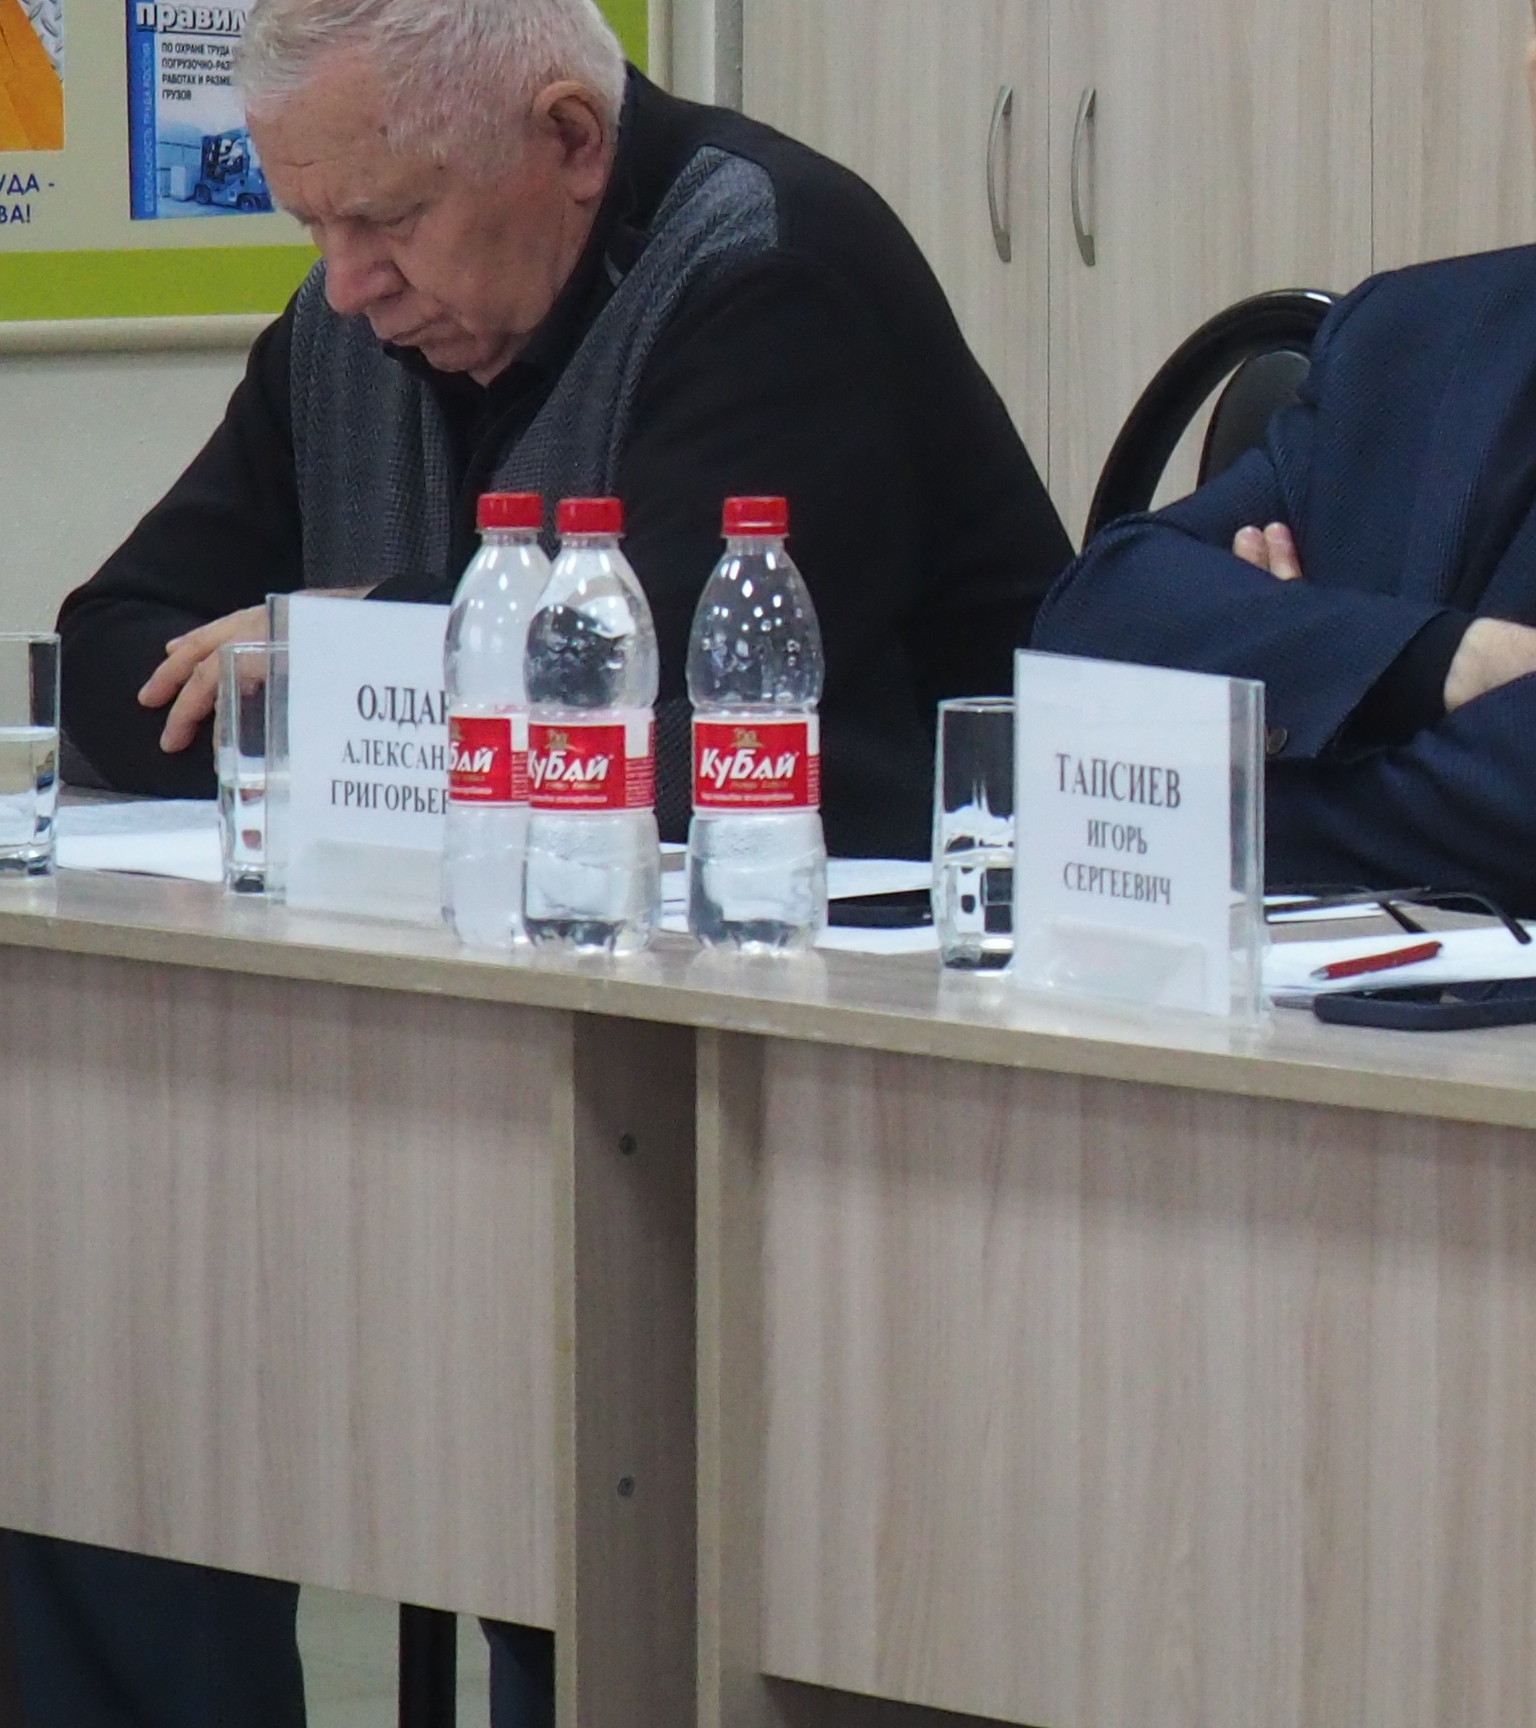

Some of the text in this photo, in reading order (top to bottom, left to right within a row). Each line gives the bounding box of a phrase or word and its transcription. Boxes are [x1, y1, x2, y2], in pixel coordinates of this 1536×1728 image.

[162, 42, 172, 53] ПО
[175, 44, 204, 55] ОХРАНЕ
[207, 45, 230, 56] ТРУДА
[162, 59, 232, 70] ПОГРУЗОЧНО-РАЗ
[162, 74, 196, 85] РАБОТАХ
[198, 76, 204, 85] И
[162, 90, 192, 100] ГРУЗОВ
[342, 738, 444, 770] АЛЕКСАН
[1056, 752, 1181, 809] ТАПСИЕВ
[1087, 819, 1148, 855] ИГОРЬ
[1063, 861, 1171, 905] СЕРГЕЕВИЧ
